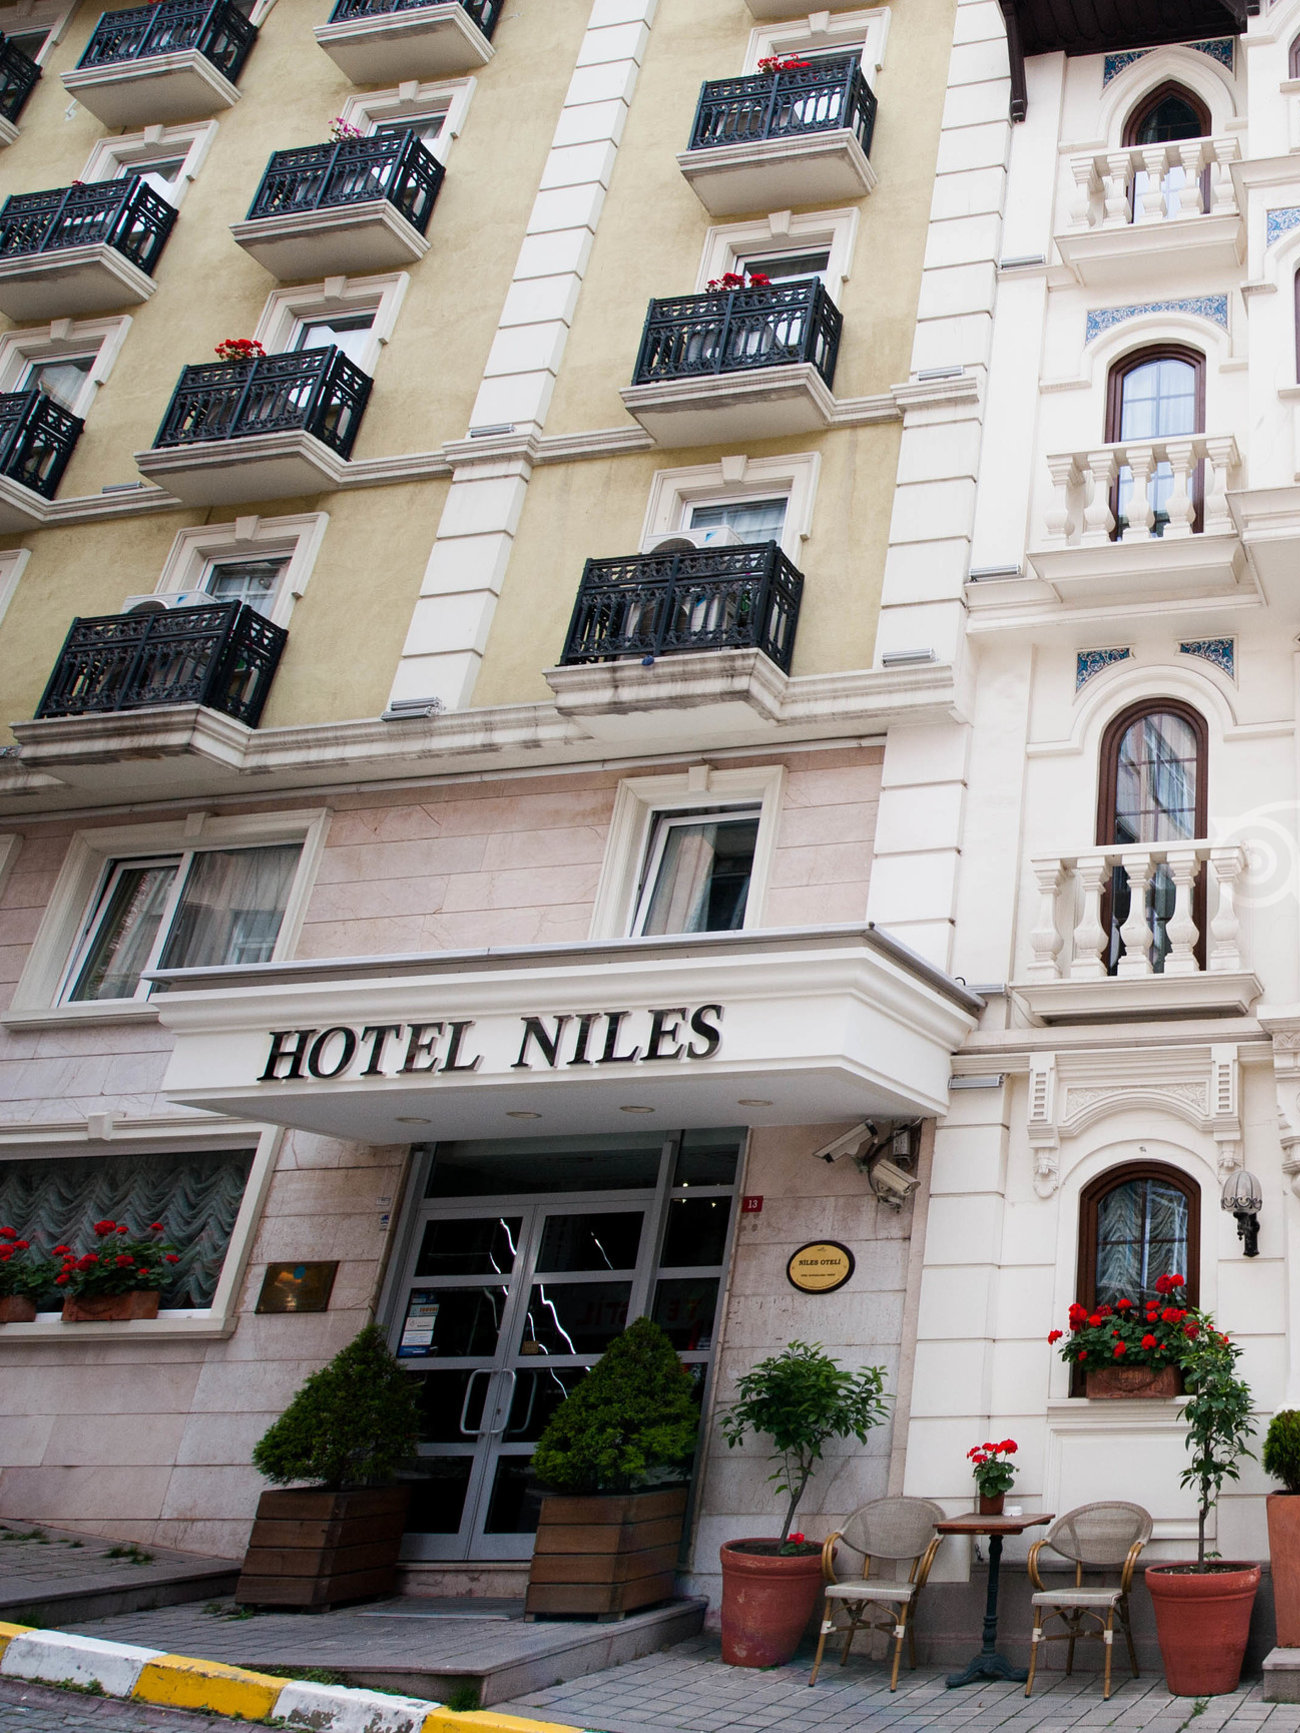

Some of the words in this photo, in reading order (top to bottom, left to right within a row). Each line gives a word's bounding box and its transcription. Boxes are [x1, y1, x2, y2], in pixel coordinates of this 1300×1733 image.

[256, 1020, 483, 1082] HOTEL
[511, 1004, 724, 1068] NILES
[748, 1199, 758, 1208] 13
